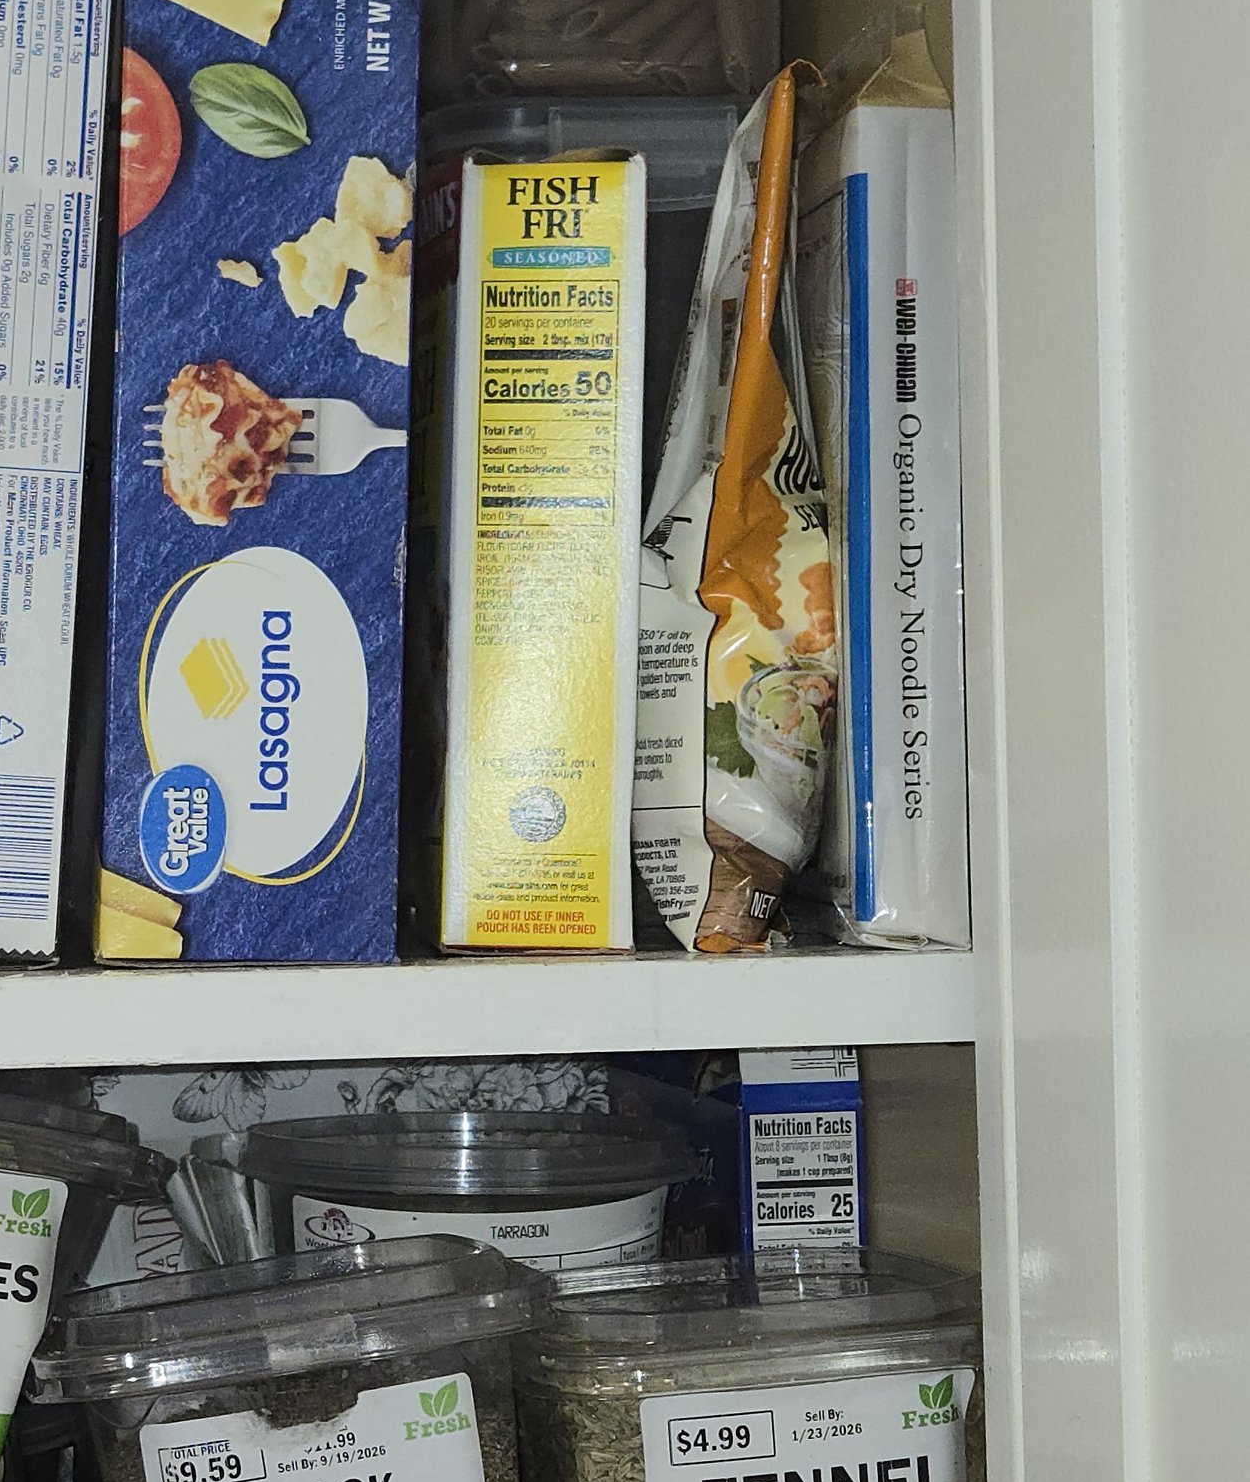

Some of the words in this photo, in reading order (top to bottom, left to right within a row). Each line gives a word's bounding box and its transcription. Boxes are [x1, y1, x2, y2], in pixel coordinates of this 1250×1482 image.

[334, 13, 345, 70] ENRICHED
[366, 28, 390, 71] NET
[507, 176, 600, 205] FISH
[64, 192, 74, 223] Total
[521, 208, 583, 239] FRI
[58, 227, 73, 313] Carbohydrate
[504, 249, 600, 264] SEASONED
[486, 286, 561, 307] Nutrition
[567, 286, 613, 307] Facts
[484, 379, 570, 398] Calories
[575, 371, 612, 395] 50
[893, 414, 923, 532] Organic
[894, 542, 924, 600] Dry
[900, 610, 926, 719] Noodle
[251, 611, 301, 812] Lasagna
[903, 731, 930, 820] Series
[159, 787, 190, 877] Great
[188, 787, 209, 855] Value
[487, 911, 501, 921] DO
[503, 911, 521, 921] NOT
[524, 911, 542, 921] USE
[545, 911, 553, 921] IF
[556, 912, 584, 922] INNER
[751, 892, 776, 918] NET
[477, 923, 509, 933] POUCH
[511, 923, 531, 933] HAS
[533, 923, 557, 934] BEEN
[559, 924, 596, 935] OPENED
[754, 1118, 811, 1136] Nutrition
[816, 1117, 851, 1134] Facts
[758, 1202, 815, 1220] Calories
[831, 1194, 853, 1217] 25
[490, 1225, 549, 1239] TARRAGON
[404, 1411, 471, 1441] Fresh
[902, 1404, 958, 1430] Fresh
[677, 1425, 751, 1455] $4.99
[791, 1423, 862, 1442] 1/23/2026
[320, 1445, 386, 1466] 9/19/2026
